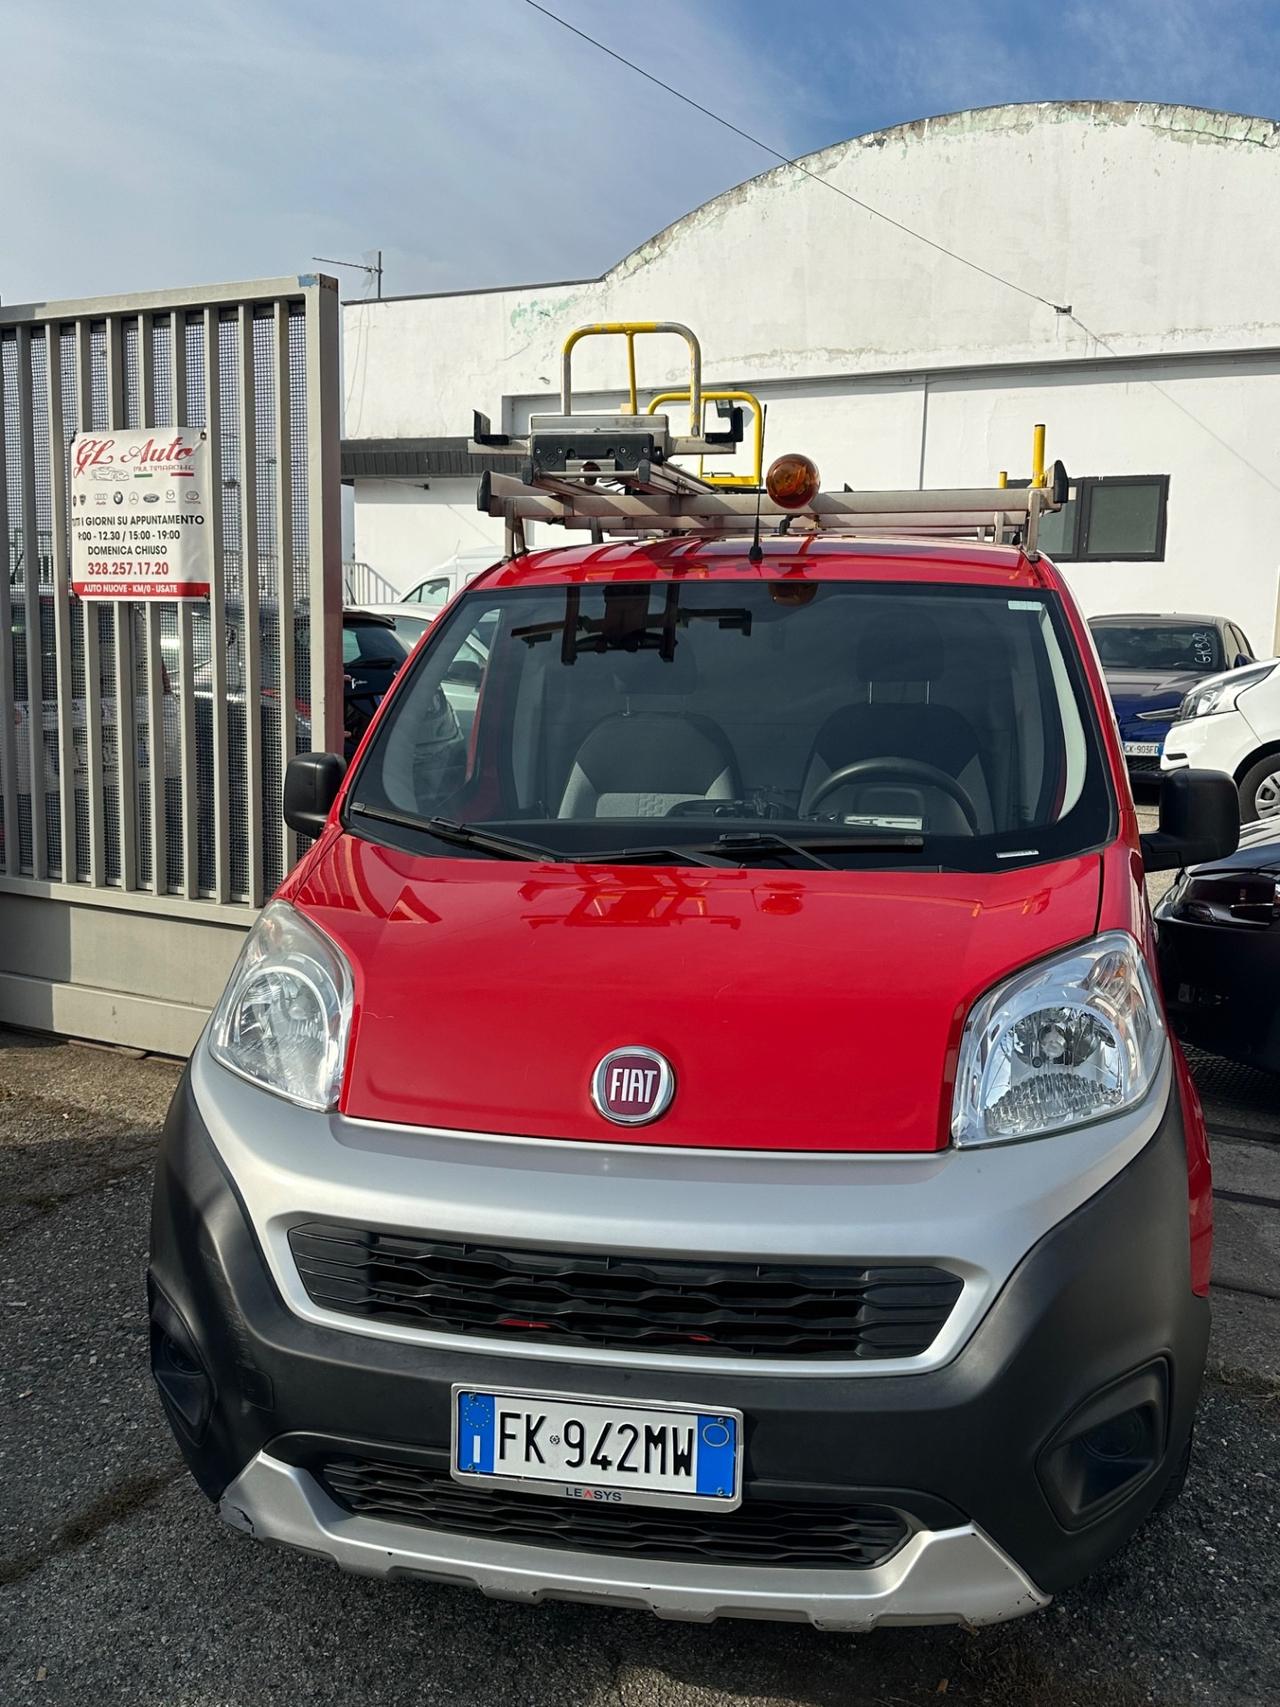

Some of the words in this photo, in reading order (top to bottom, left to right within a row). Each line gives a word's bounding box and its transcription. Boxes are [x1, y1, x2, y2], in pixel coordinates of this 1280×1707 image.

[73, 439, 115, 478] GL
[120, 436, 193, 464] Auto
[86, 516, 115, 526] GIORNI
[117, 515, 128, 525] SU
[130, 514, 205, 525] APPUNTAMENTO
[99, 531, 120, 540] 12.30
[129, 530, 150, 540] 15:00
[157, 530, 180, 540] 19:00
[88, 546, 133, 555] DOMENICA
[135, 545, 167, 555] CHIUSO
[88, 562, 169, 575] 328.257.17.20
[83, 584, 101, 592] AUTO
[103, 584, 128, 592] NUOVE
[133, 584, 151, 594] KM/0
[156, 584, 178, 592] USATE
[610, 1068, 658, 1103] FIAT
[565, 1487, 622, 1502] LEASYS
